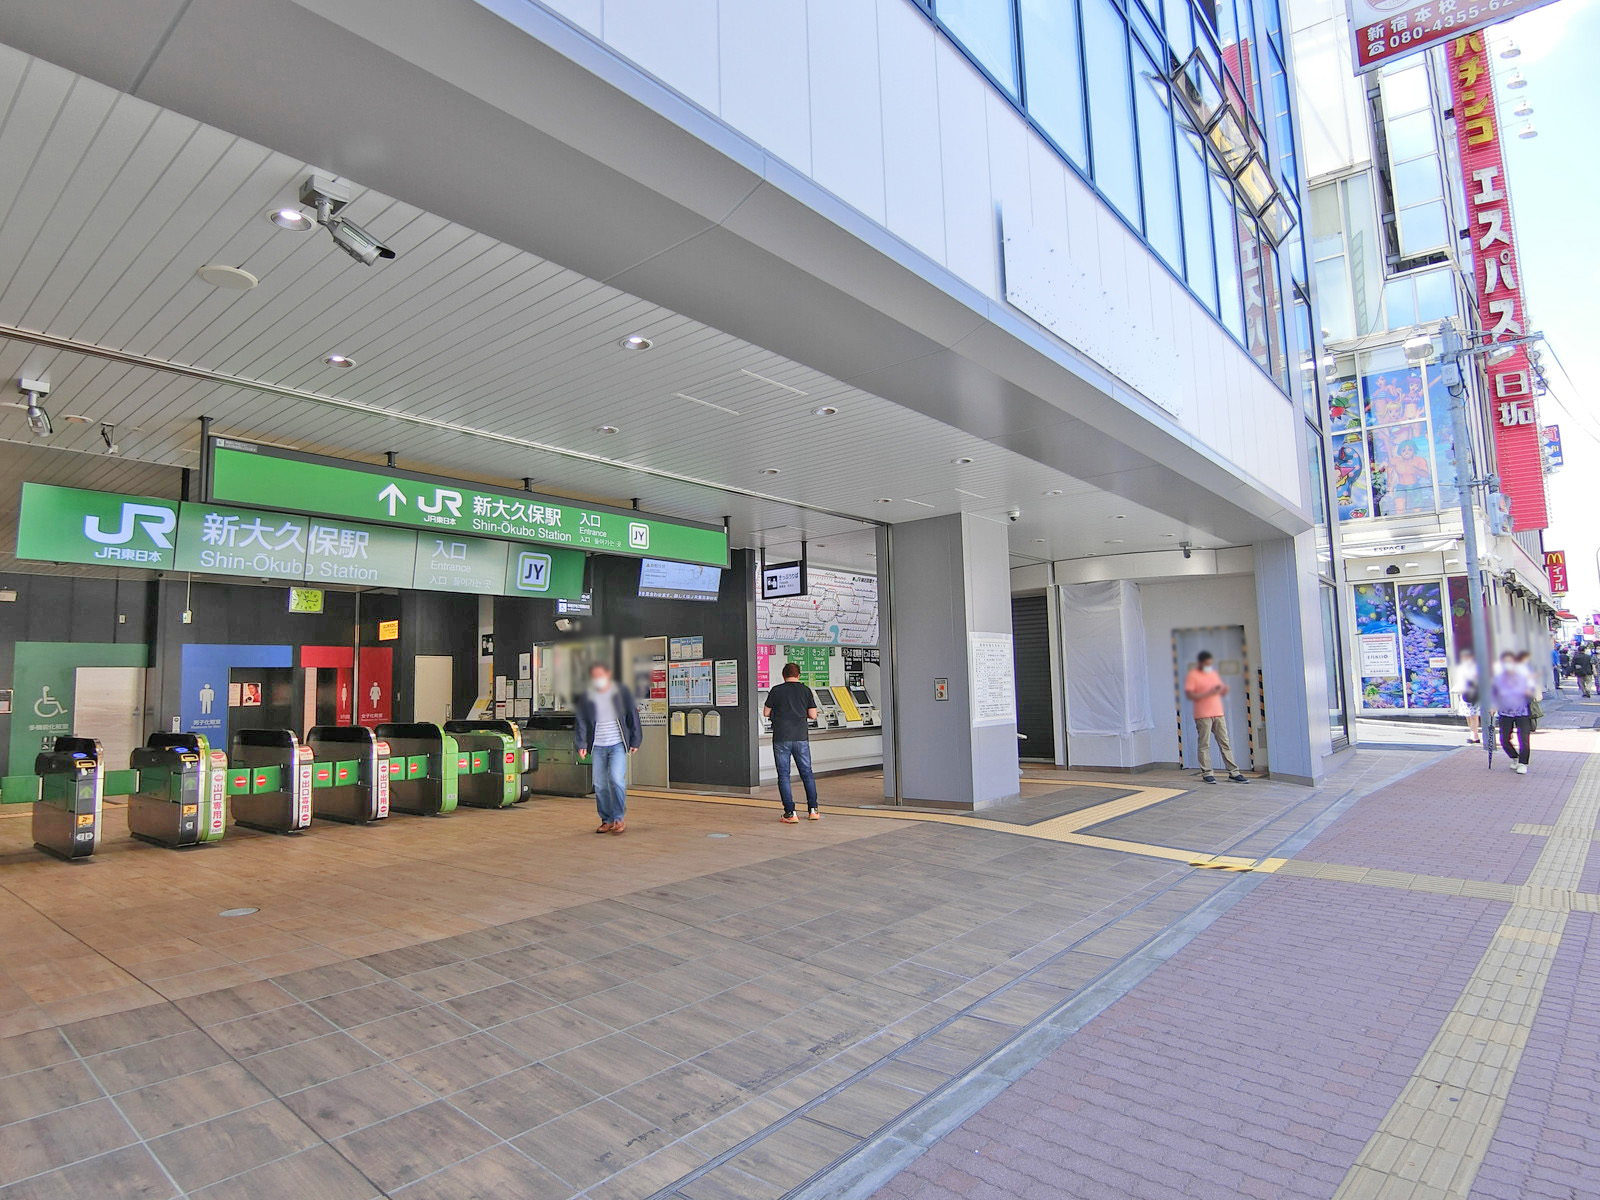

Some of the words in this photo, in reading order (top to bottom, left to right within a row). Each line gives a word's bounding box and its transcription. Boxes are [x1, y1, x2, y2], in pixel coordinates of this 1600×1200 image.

[1367, 0, 1457, 41] 新宿本校
[1472, 166, 1522, 341] エスパス
[417, 488, 463, 518] JR
[473, 495, 562, 528] 新大久保駅
[83, 502, 177, 550] JR
[423, 514, 457, 526] JR東日本
[472, 518, 536, 538] Shin-Ōkubo
[537, 527, 572, 542] Station
[579, 512, 601, 528] 入口
[579, 526, 608, 538] Entrance
[201, 511, 370, 561] 新大久保駅
[633, 530, 645, 541] JY
[94, 546, 163, 564] JR東日本
[431, 539, 468, 561] 入口
[200, 549, 314, 577] Shin-Ōkubo
[319, 560, 379, 581] Station
[430, 559, 472, 574] Entrance
[524, 563, 545, 580] JY
[1553, 566, 1565, 591] イフル
[213, 784, 223, 820] 出口専用
[301, 780, 310, 813] 出口専用
[379, 774, 388, 805] 出口専用
